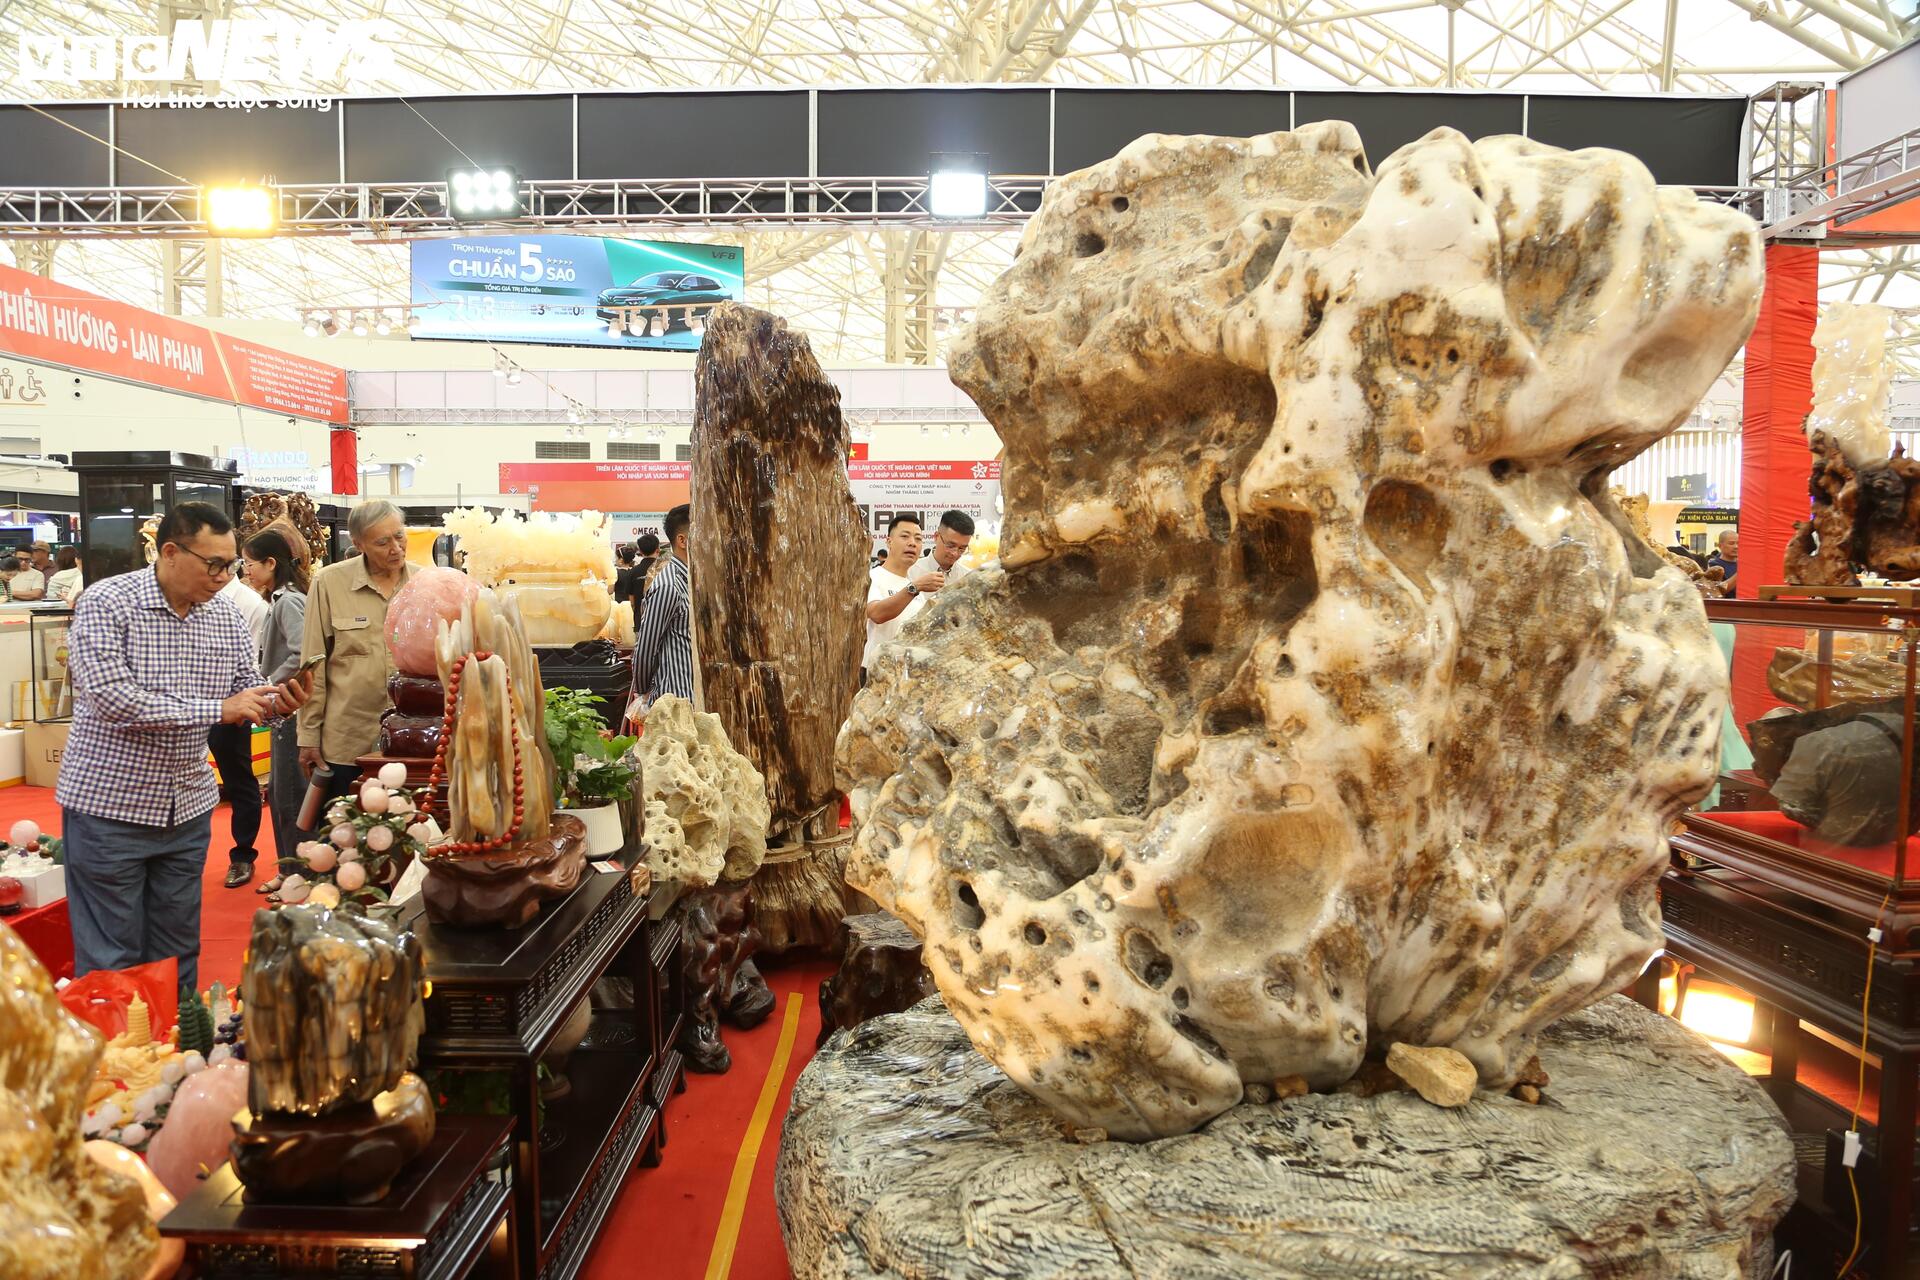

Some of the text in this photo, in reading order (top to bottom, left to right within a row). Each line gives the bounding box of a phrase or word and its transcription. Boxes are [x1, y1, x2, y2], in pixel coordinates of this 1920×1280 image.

[448, 243, 576, 283] CHUẨN 5 SAO
[53, 305, 119, 354] HƯƠNG
[130, 328, 160, 365] LAN
[162, 338, 204, 381] PHẠM
[632, 527, 659, 535] OMEGA
